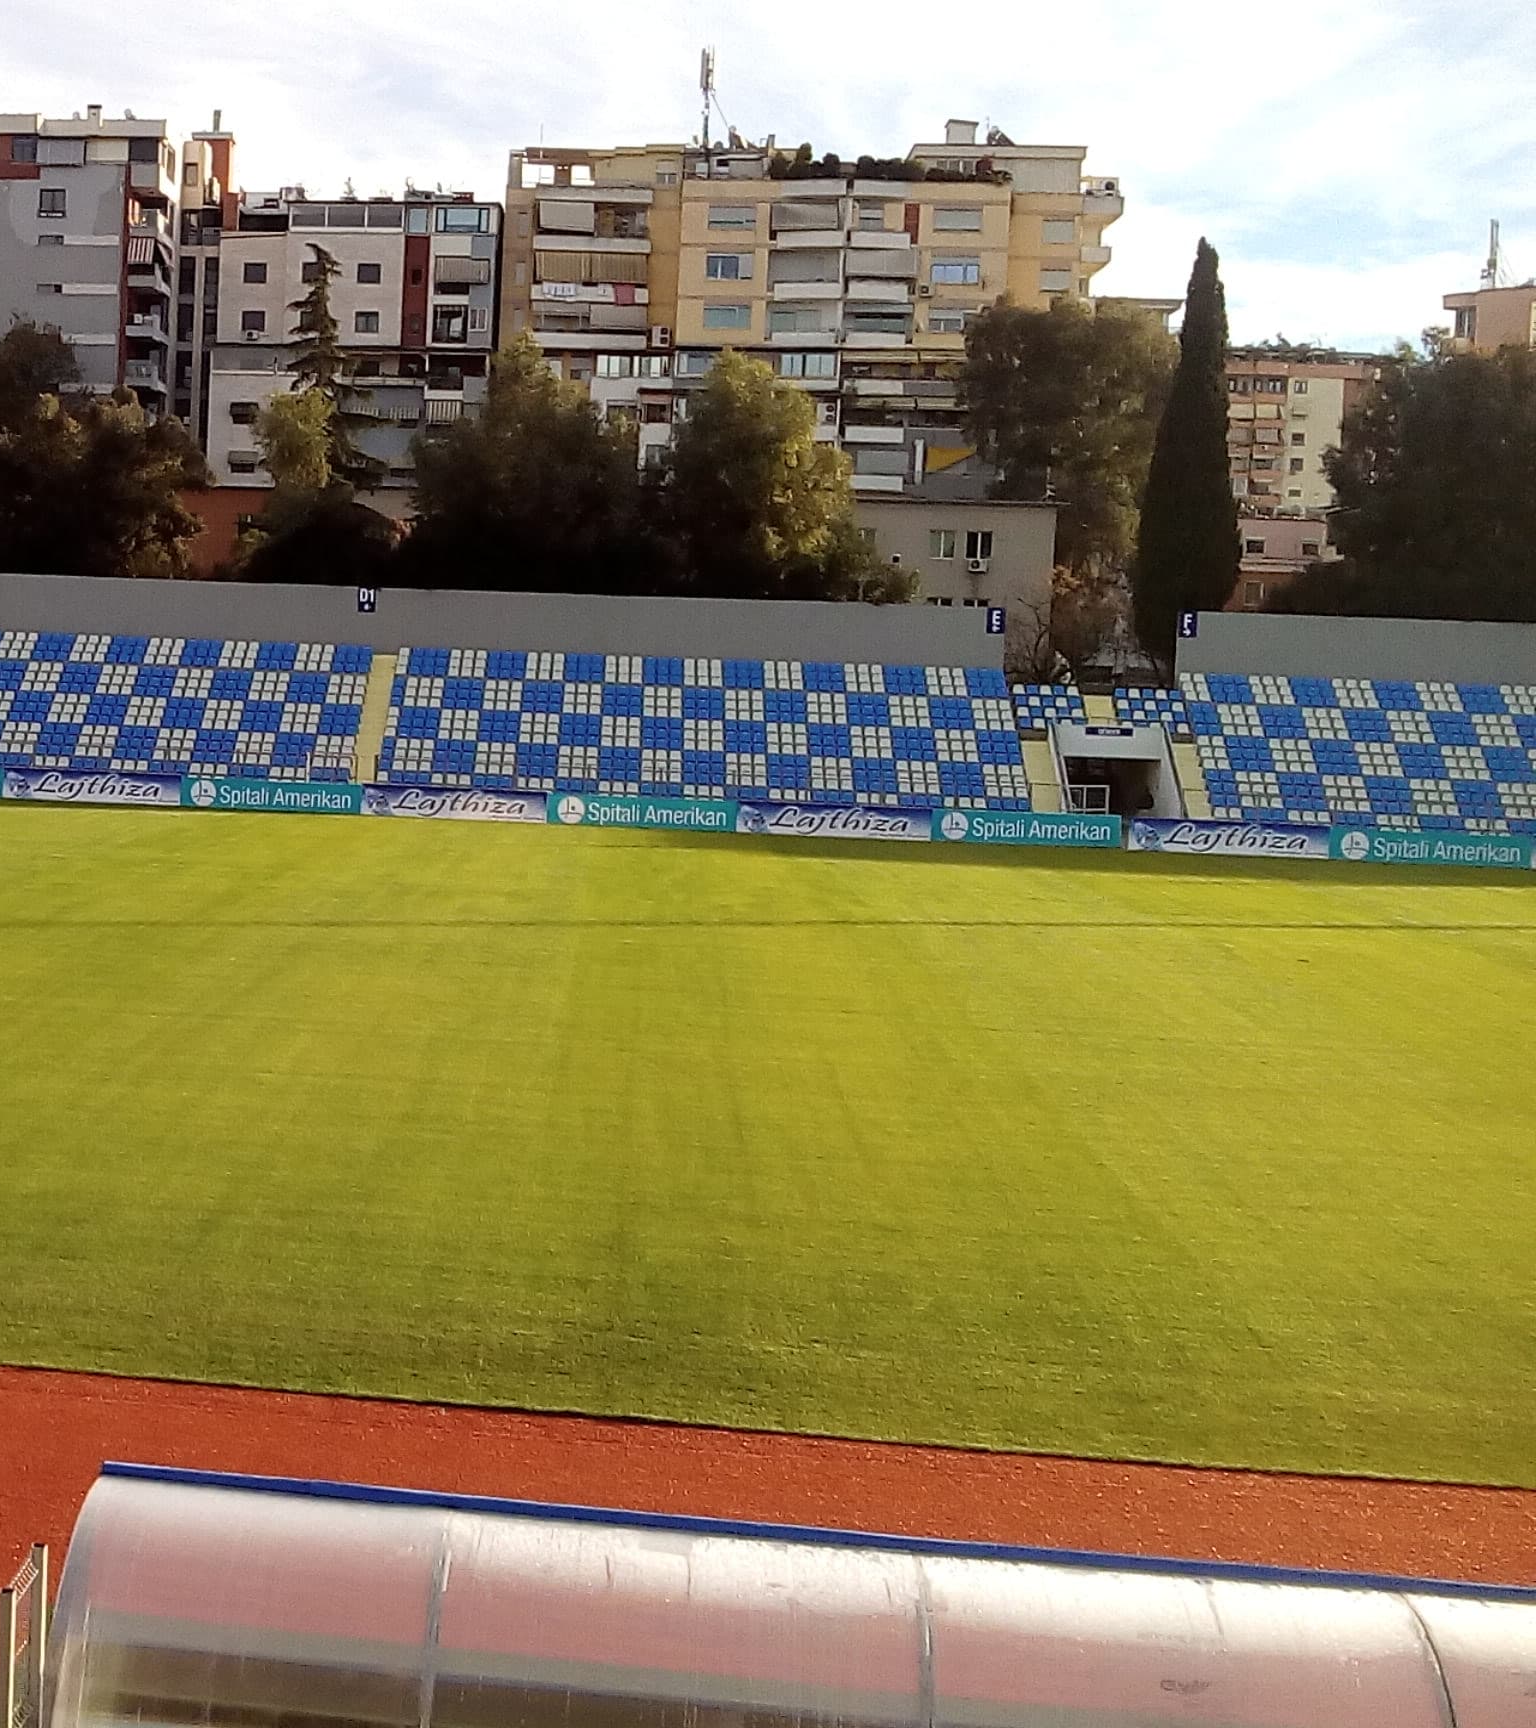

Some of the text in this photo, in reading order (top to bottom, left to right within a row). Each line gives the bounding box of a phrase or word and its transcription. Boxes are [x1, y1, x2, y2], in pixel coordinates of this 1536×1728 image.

[360, 588, 374, 603] D1
[992, 610, 1001, 625] E
[1184, 613, 1193, 628] F
[33, 772, 162, 799] Lajthiza
[219, 783, 352, 809] Spitali Amerikan
[392, 788, 526, 817] Lajthiza
[587, 801, 727, 827] Spitali Amerikan
[769, 806, 908, 834] Lajthiza
[972, 816, 1111, 841] Spitali Amerikan
[1164, 822, 1307, 852] Lajthiza
[1373, 836, 1521, 863] Spitali Amerikan
